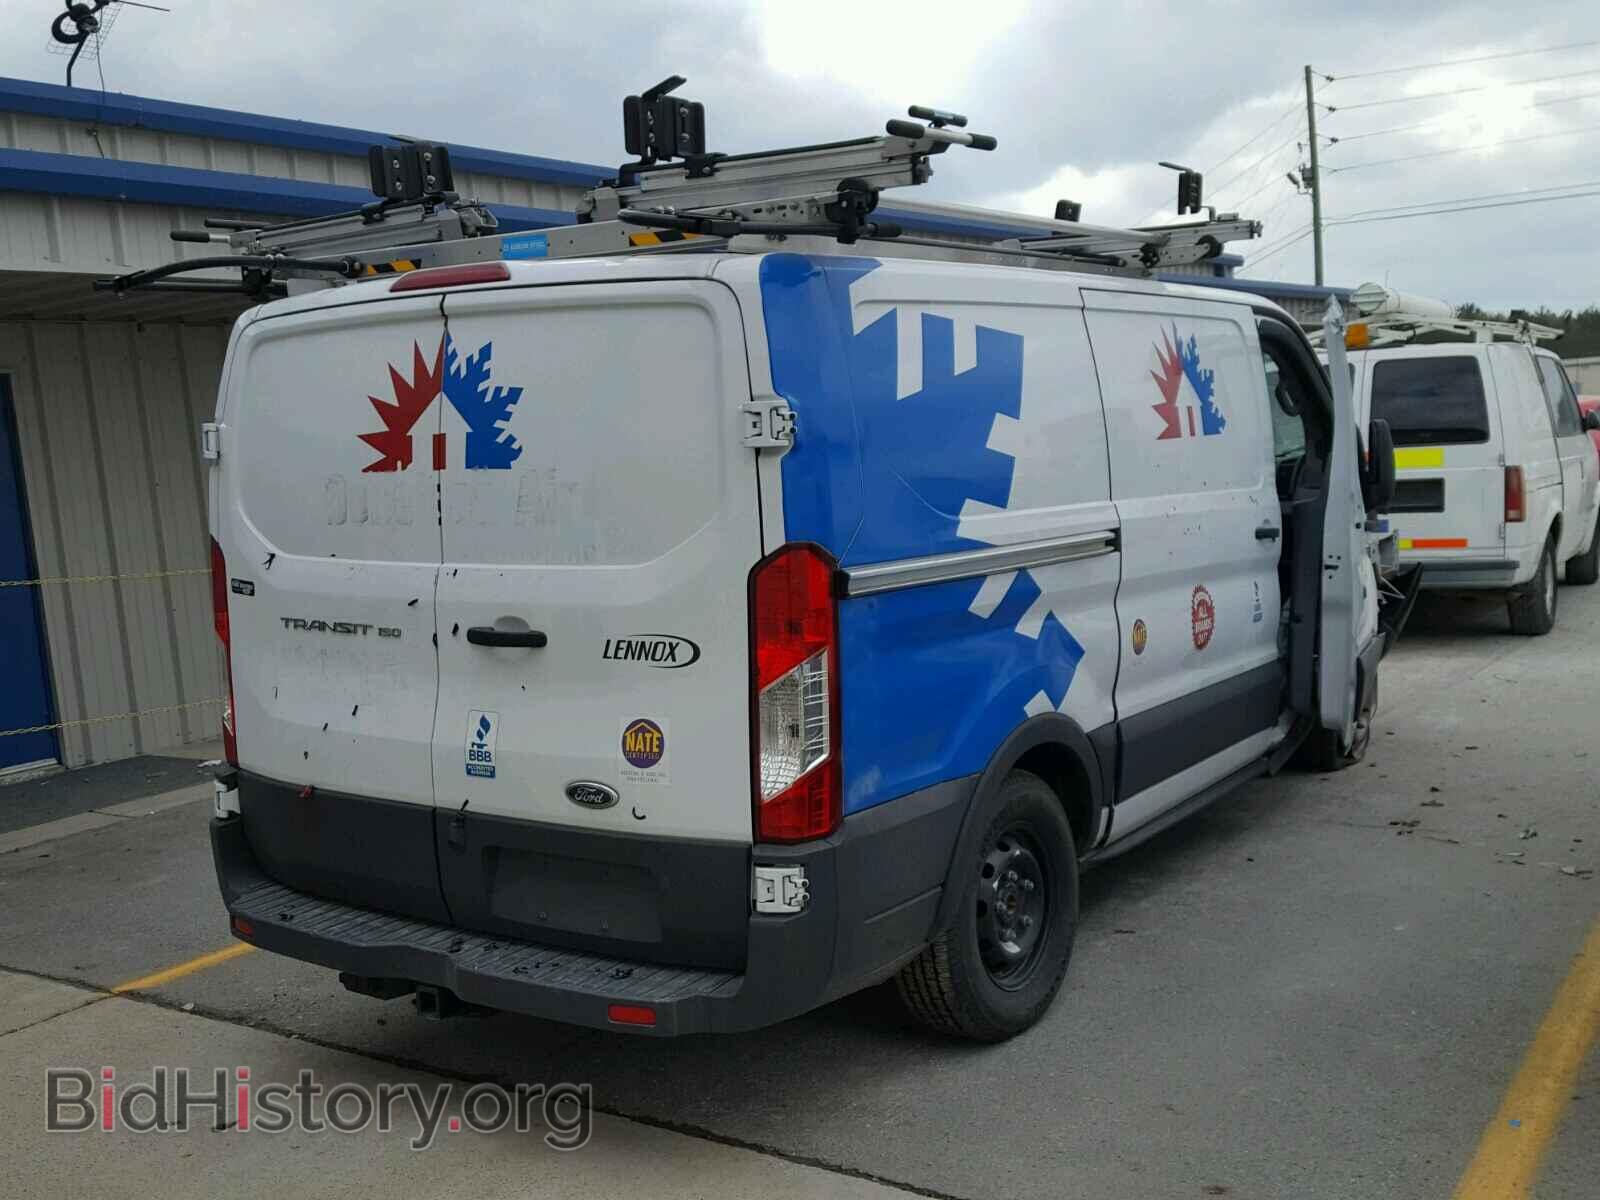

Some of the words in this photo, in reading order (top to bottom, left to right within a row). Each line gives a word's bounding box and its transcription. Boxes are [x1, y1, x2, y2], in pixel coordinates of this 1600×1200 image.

[279, 616, 374, 636] TRANSIT
[377, 626, 402, 639] 150
[602, 638, 680, 663] LENNOX
[626, 731, 661, 753] NATE
[468, 748, 493, 763] BBB
[574, 784, 605, 804] Ford
